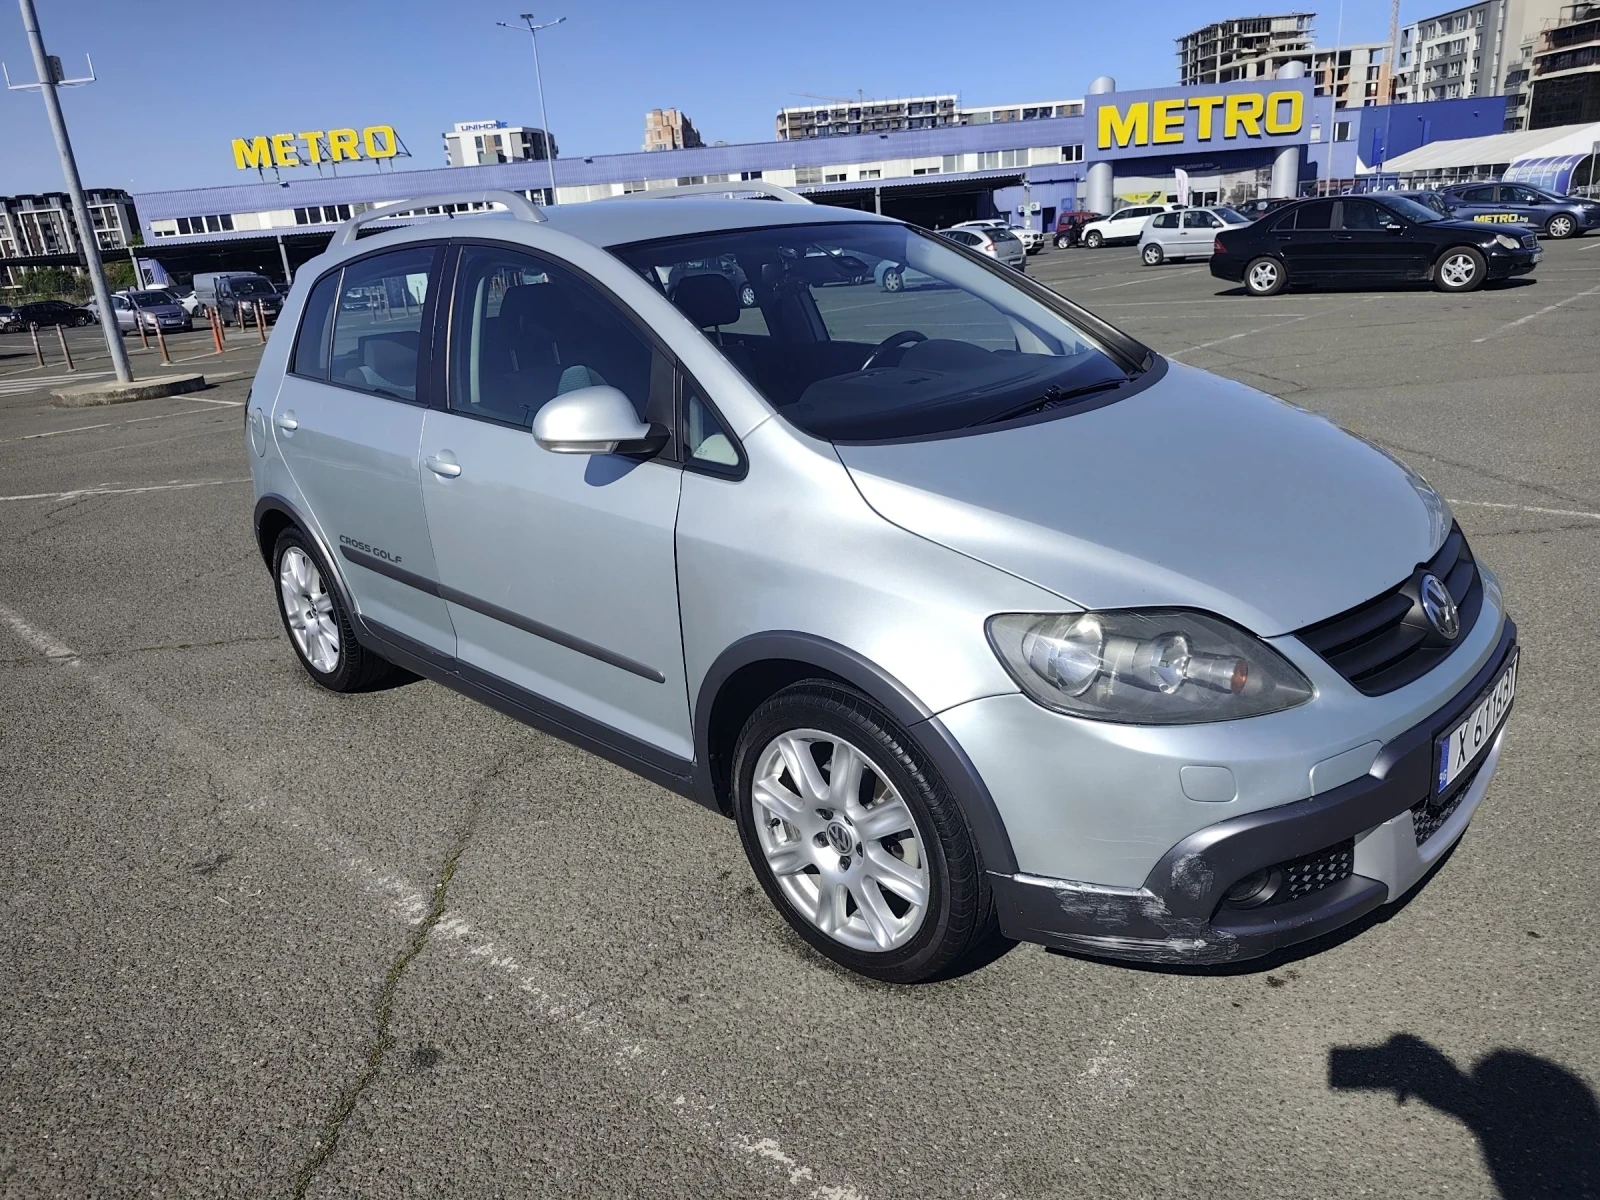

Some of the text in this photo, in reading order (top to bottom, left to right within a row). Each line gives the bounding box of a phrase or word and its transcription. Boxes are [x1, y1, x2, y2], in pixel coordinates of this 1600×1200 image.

[461, 122, 508, 131] UNIHOME
[1097, 90, 1304, 149] METRO
[231, 125, 397, 170] METRO
[1473, 213, 1529, 223] METRO.bg
[340, 534, 403, 563] CROSS GOLF
